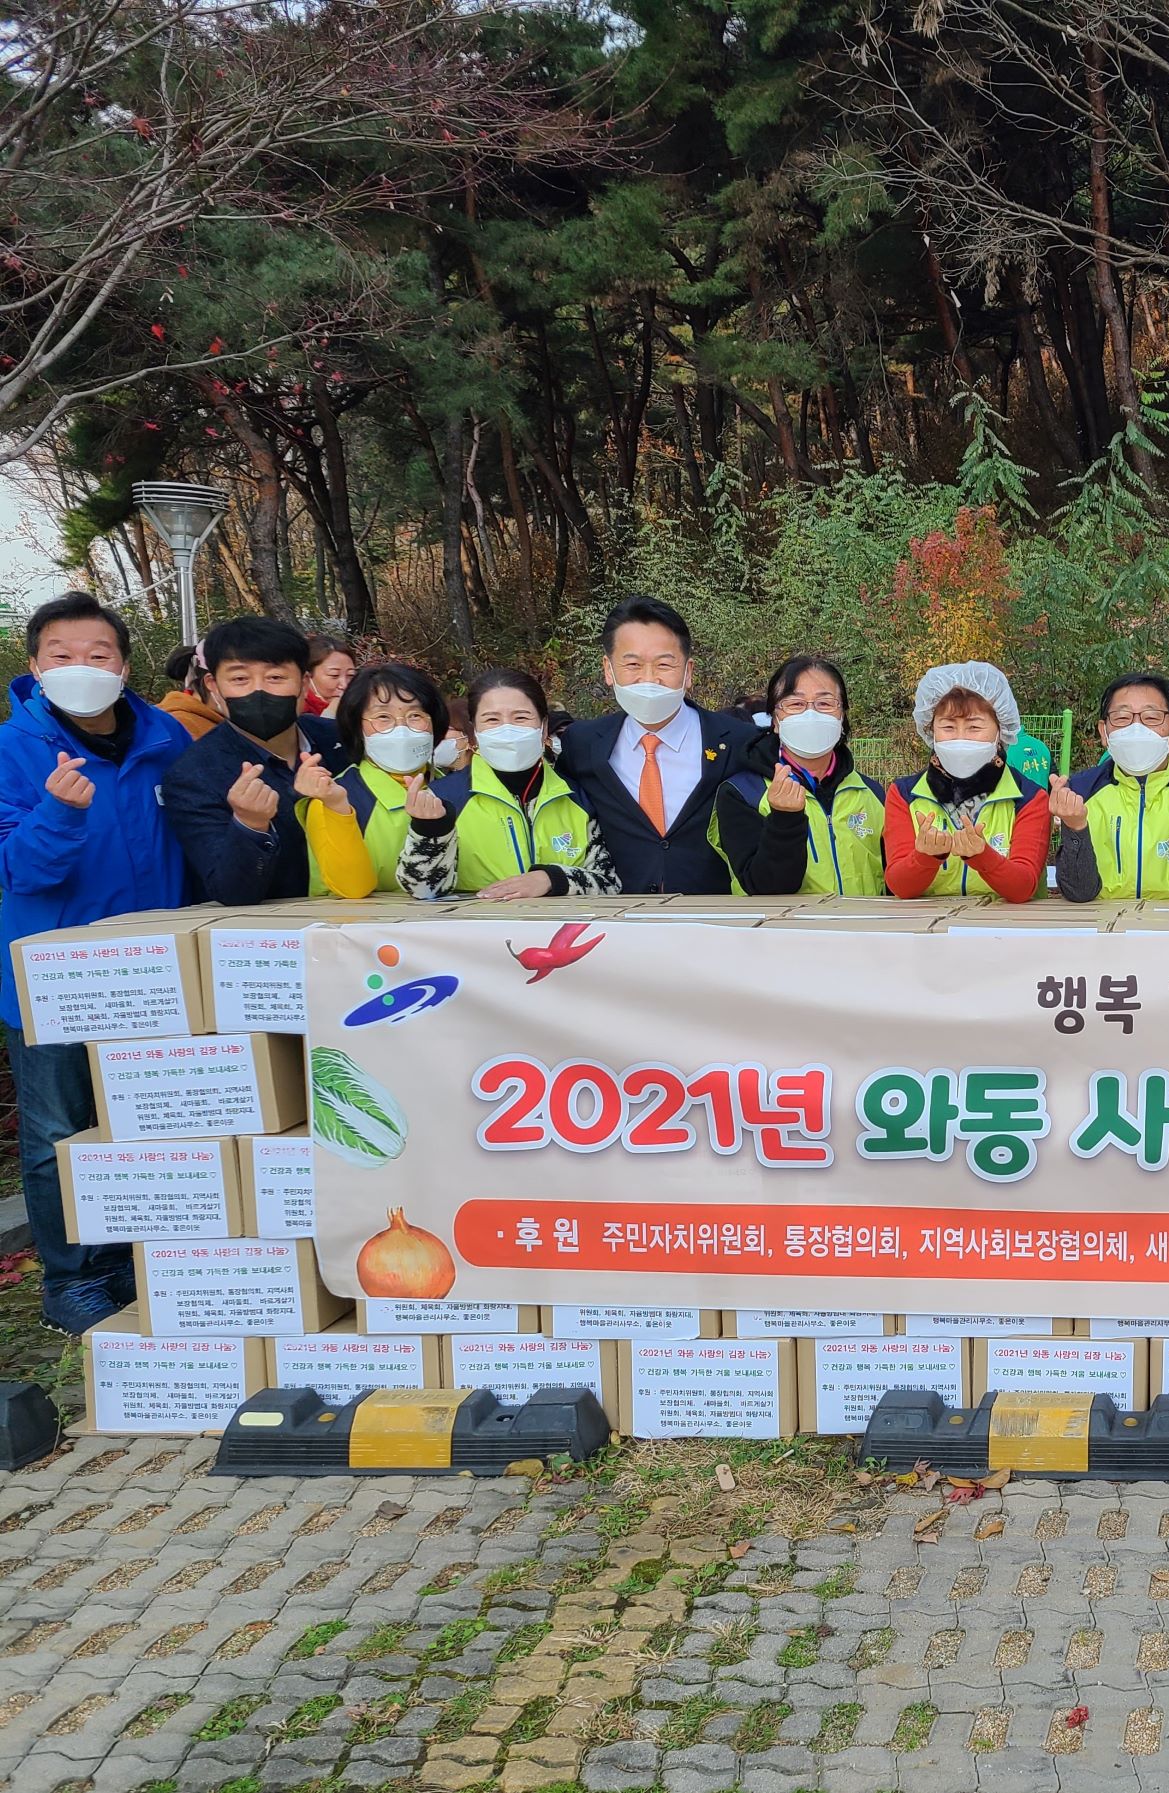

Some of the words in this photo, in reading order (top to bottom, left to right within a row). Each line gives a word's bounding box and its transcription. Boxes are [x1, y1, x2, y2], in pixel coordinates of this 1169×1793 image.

[1037, 974, 1142, 1035] 행복
[478, 1059, 829, 1163] 2021년
[863, 1072, 1047, 1176] 와동
[601, 1221, 774, 1258] 주민자치위원회,
[783, 1224, 908, 1260] 통장협의회,
[918, 1226, 1136, 1264] 지역사회보장협의체,
